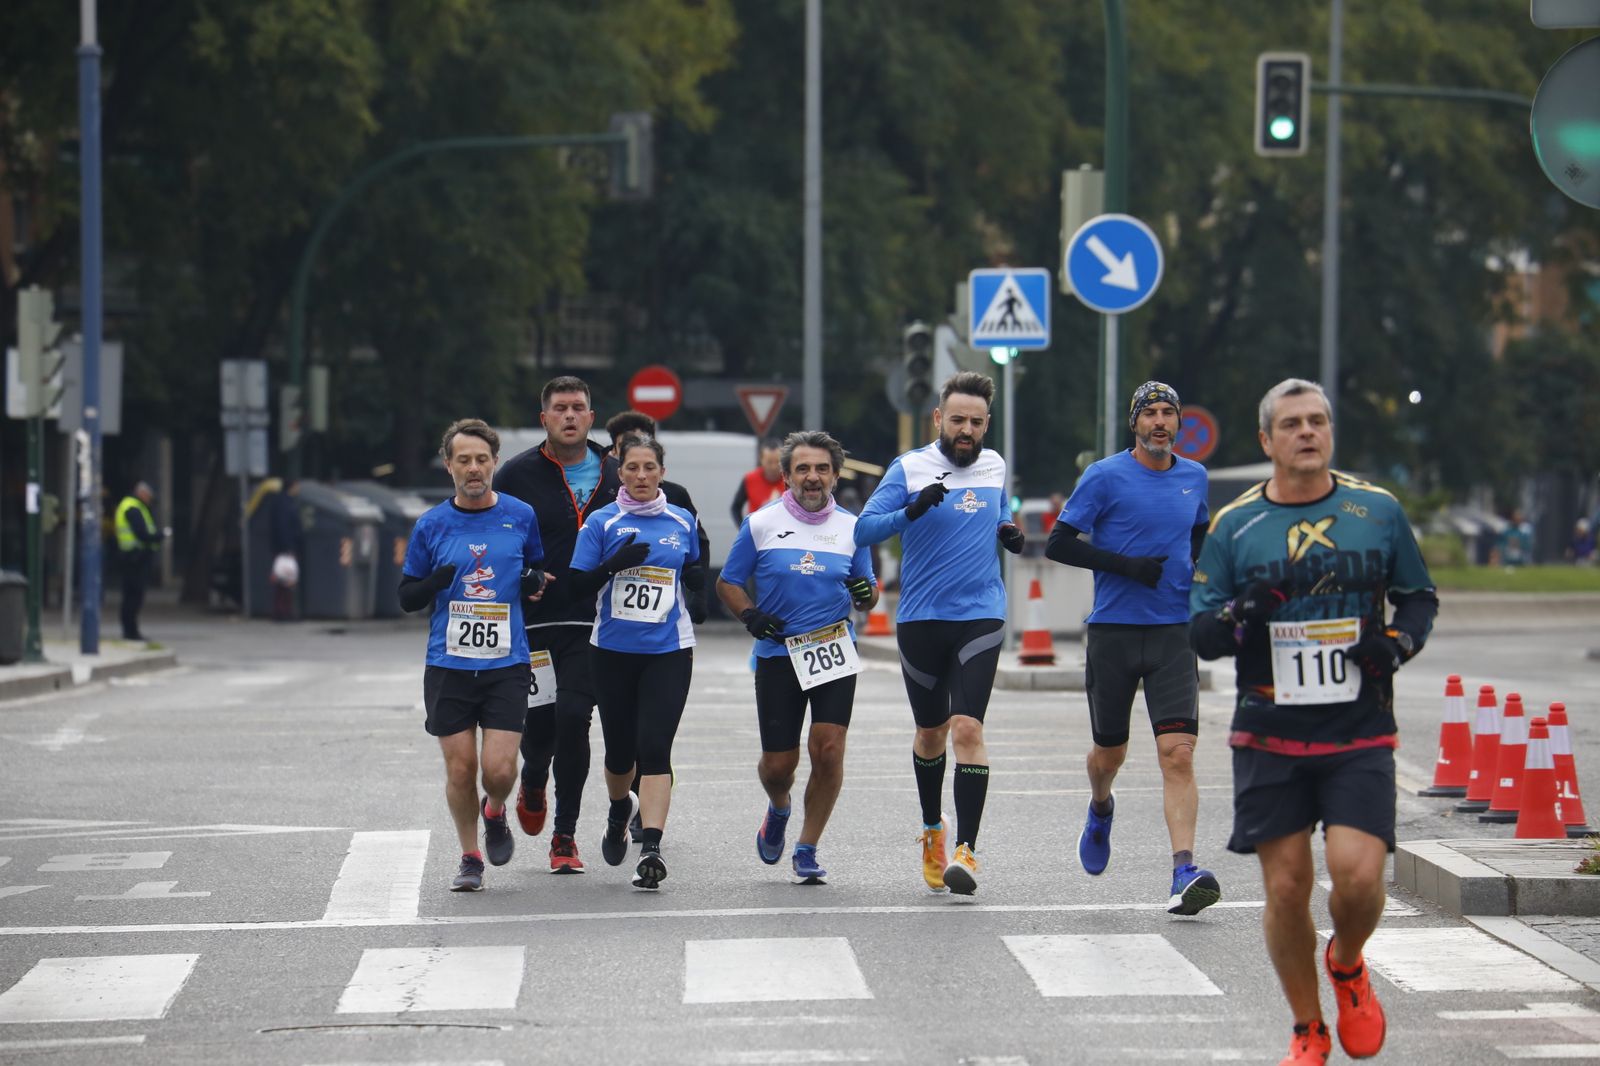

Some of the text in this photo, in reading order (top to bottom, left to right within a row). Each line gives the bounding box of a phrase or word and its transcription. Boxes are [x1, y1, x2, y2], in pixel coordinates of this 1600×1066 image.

[623, 583, 663, 610] 267
[458, 621, 499, 648] 265
[803, 642, 846, 676] 269
[1292, 648, 1346, 687] 110
